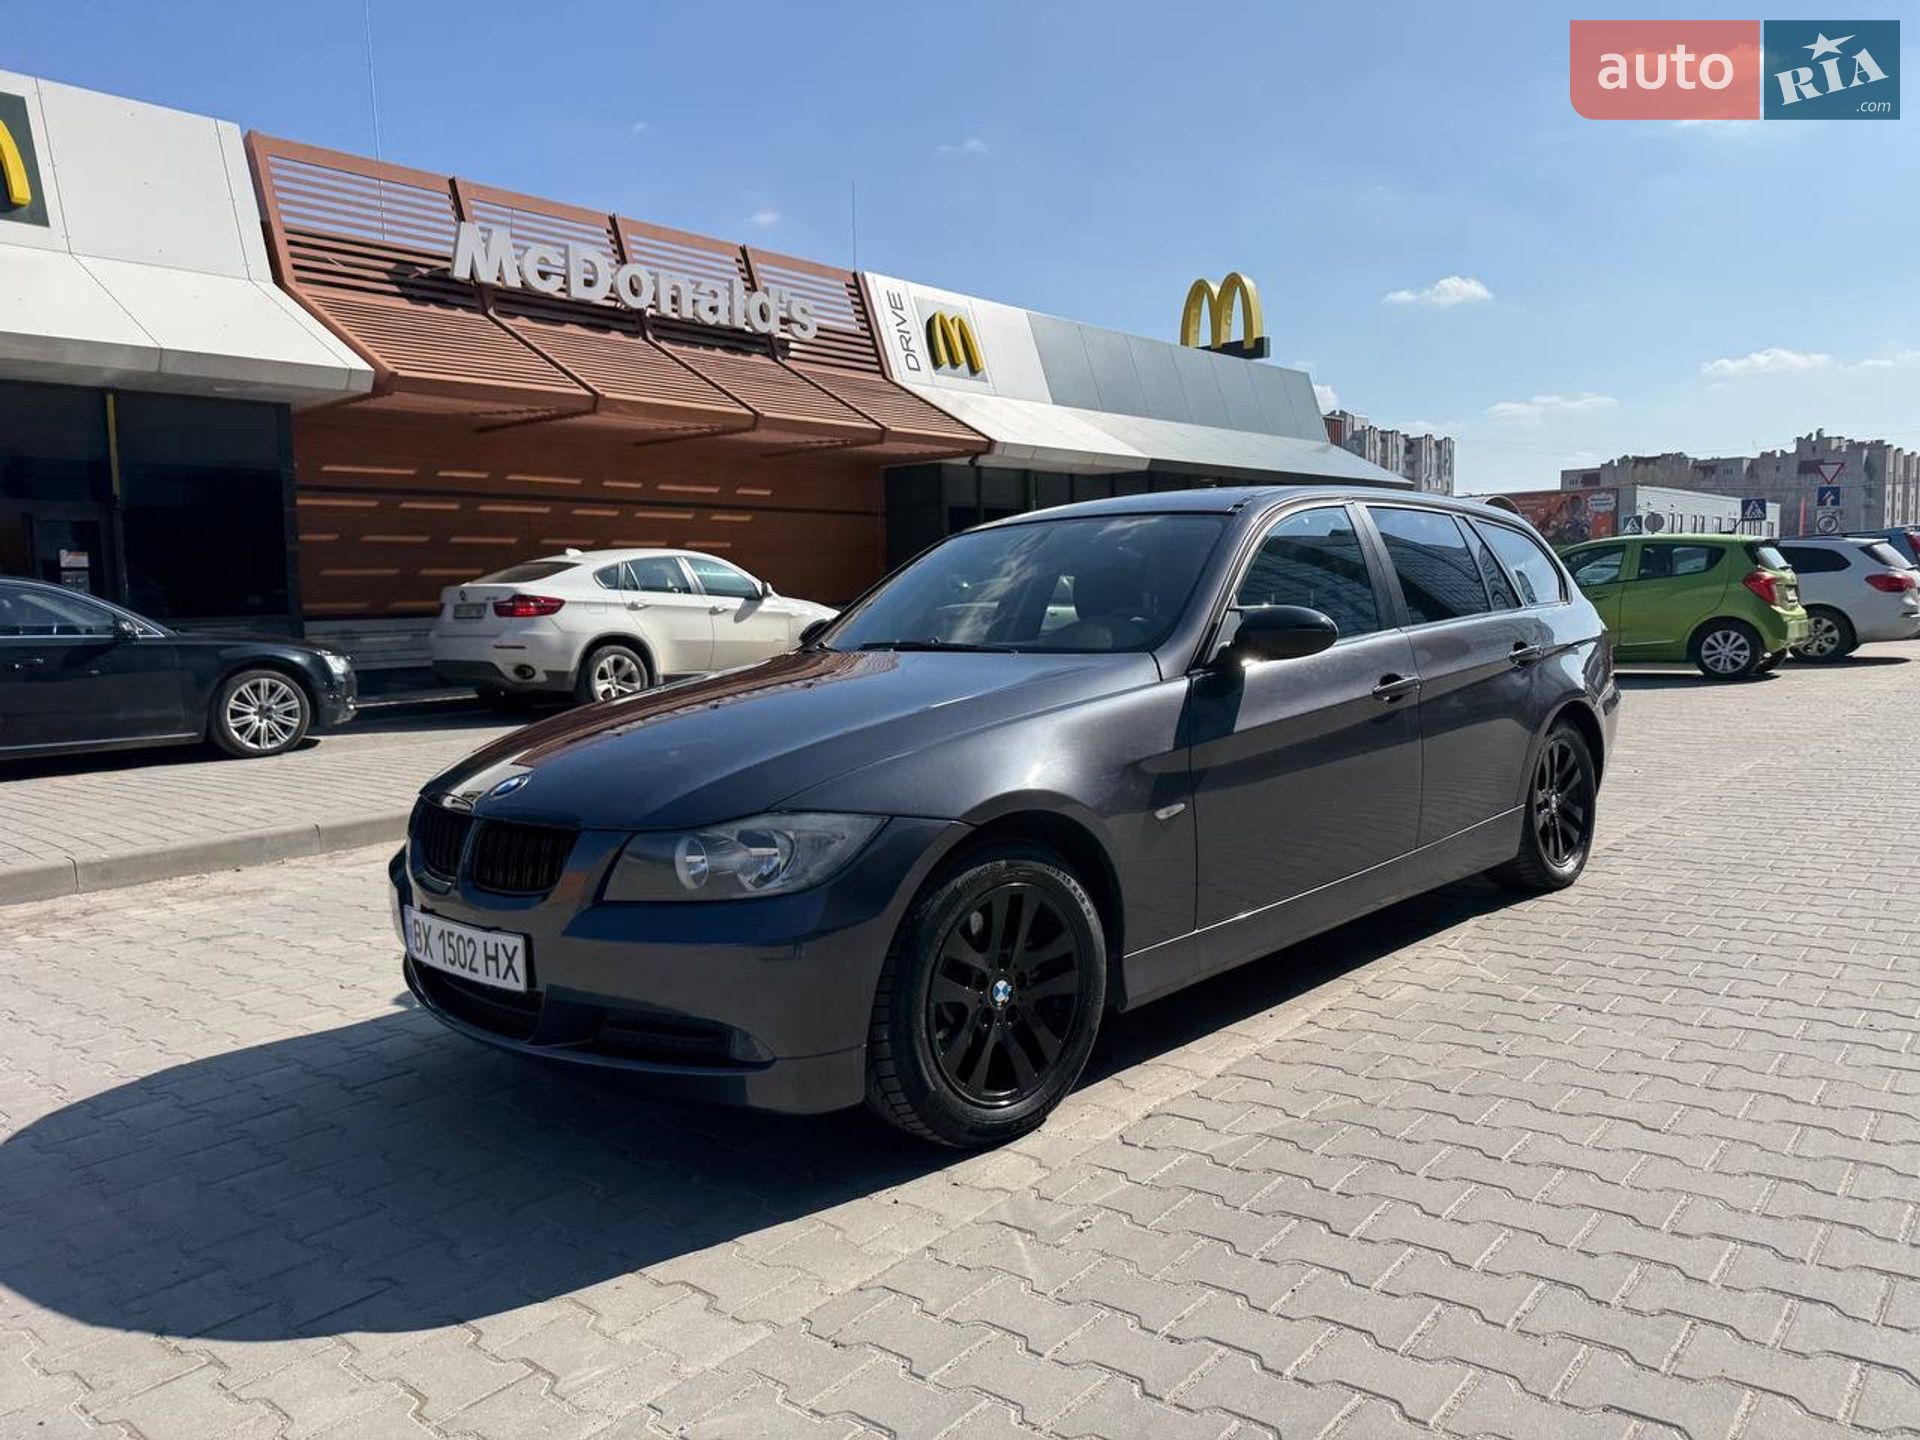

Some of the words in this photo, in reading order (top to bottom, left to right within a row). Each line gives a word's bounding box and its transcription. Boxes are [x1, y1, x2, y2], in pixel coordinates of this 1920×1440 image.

[449, 220, 818, 340] McDonald's
[887, 291, 921, 372] DRIVE
[413, 919, 433, 960] BX
[438, 928, 479, 973] 1502
[483, 940, 520, 983] HX
